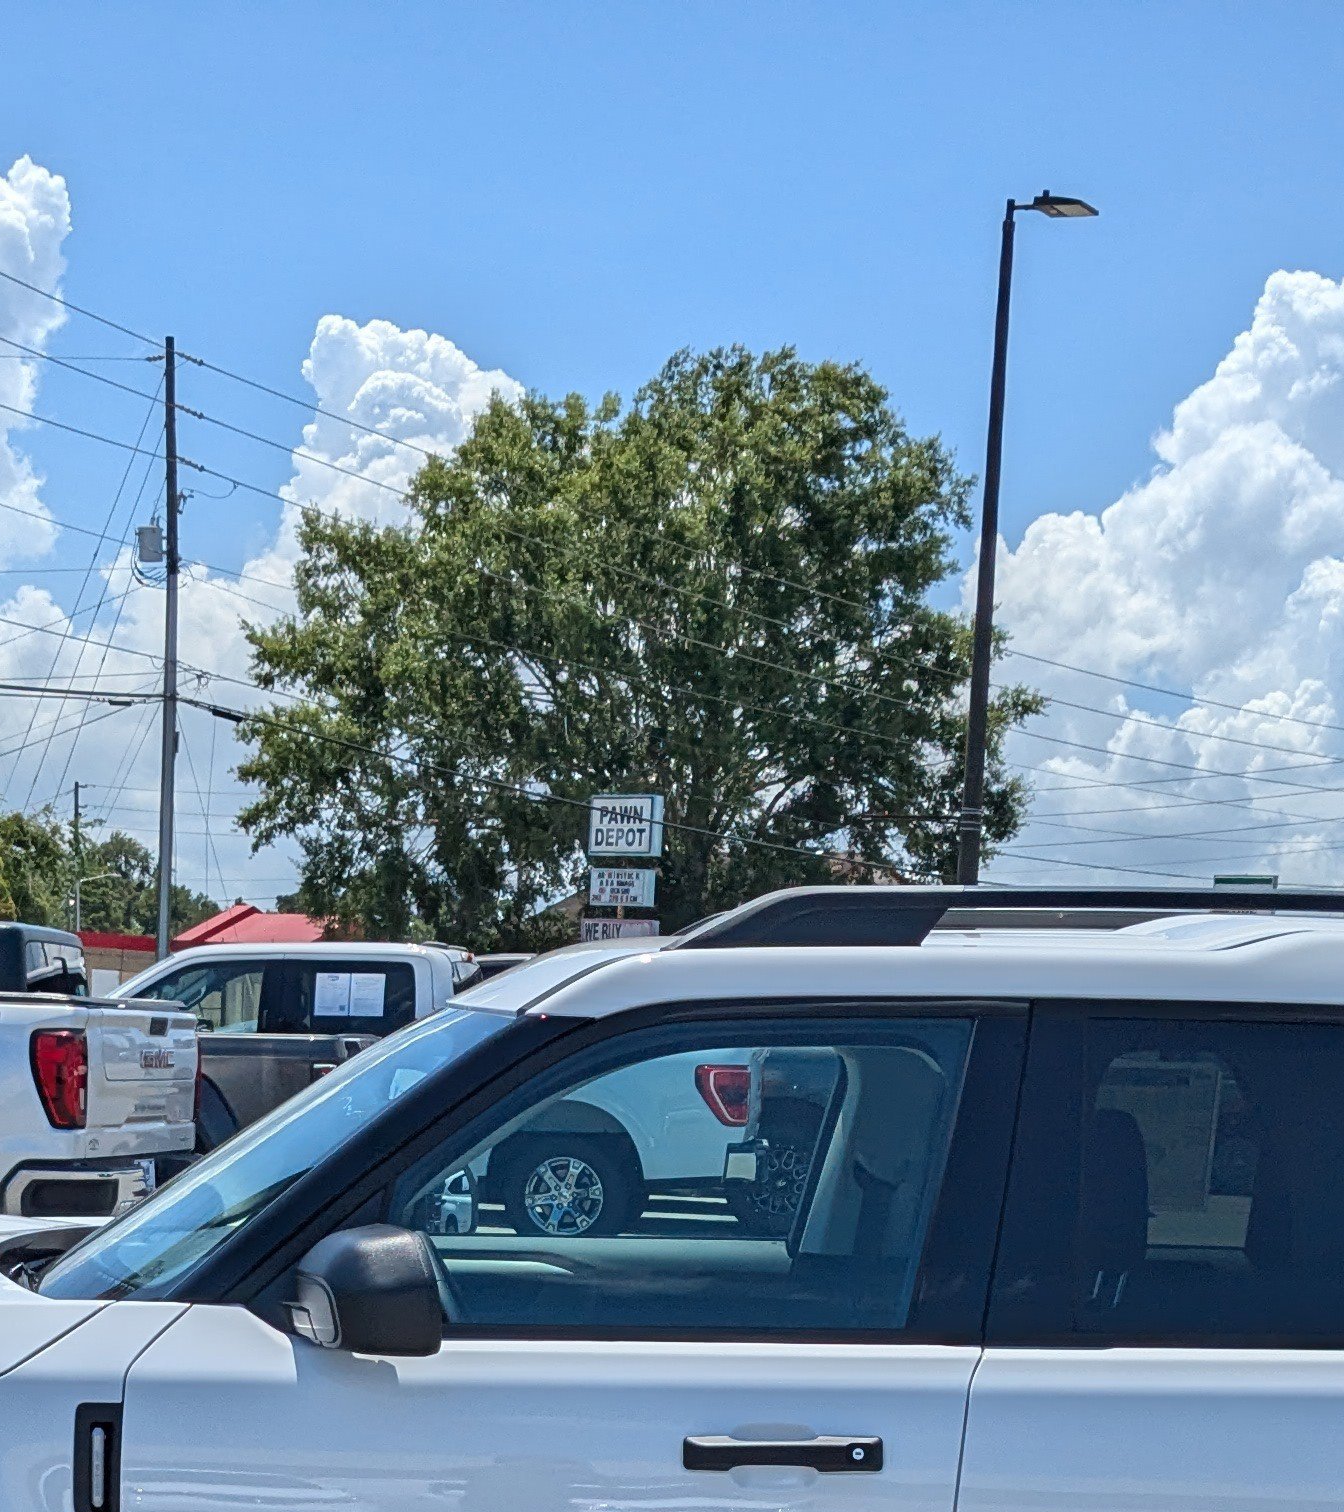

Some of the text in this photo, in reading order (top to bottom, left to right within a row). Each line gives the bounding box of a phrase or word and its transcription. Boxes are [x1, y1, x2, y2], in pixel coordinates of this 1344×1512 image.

[599, 806, 644, 825] PAWN
[594, 828, 646, 847] DEPOT
[584, 923, 599, 942] WE
[140, 1048, 175, 1068] GMC
